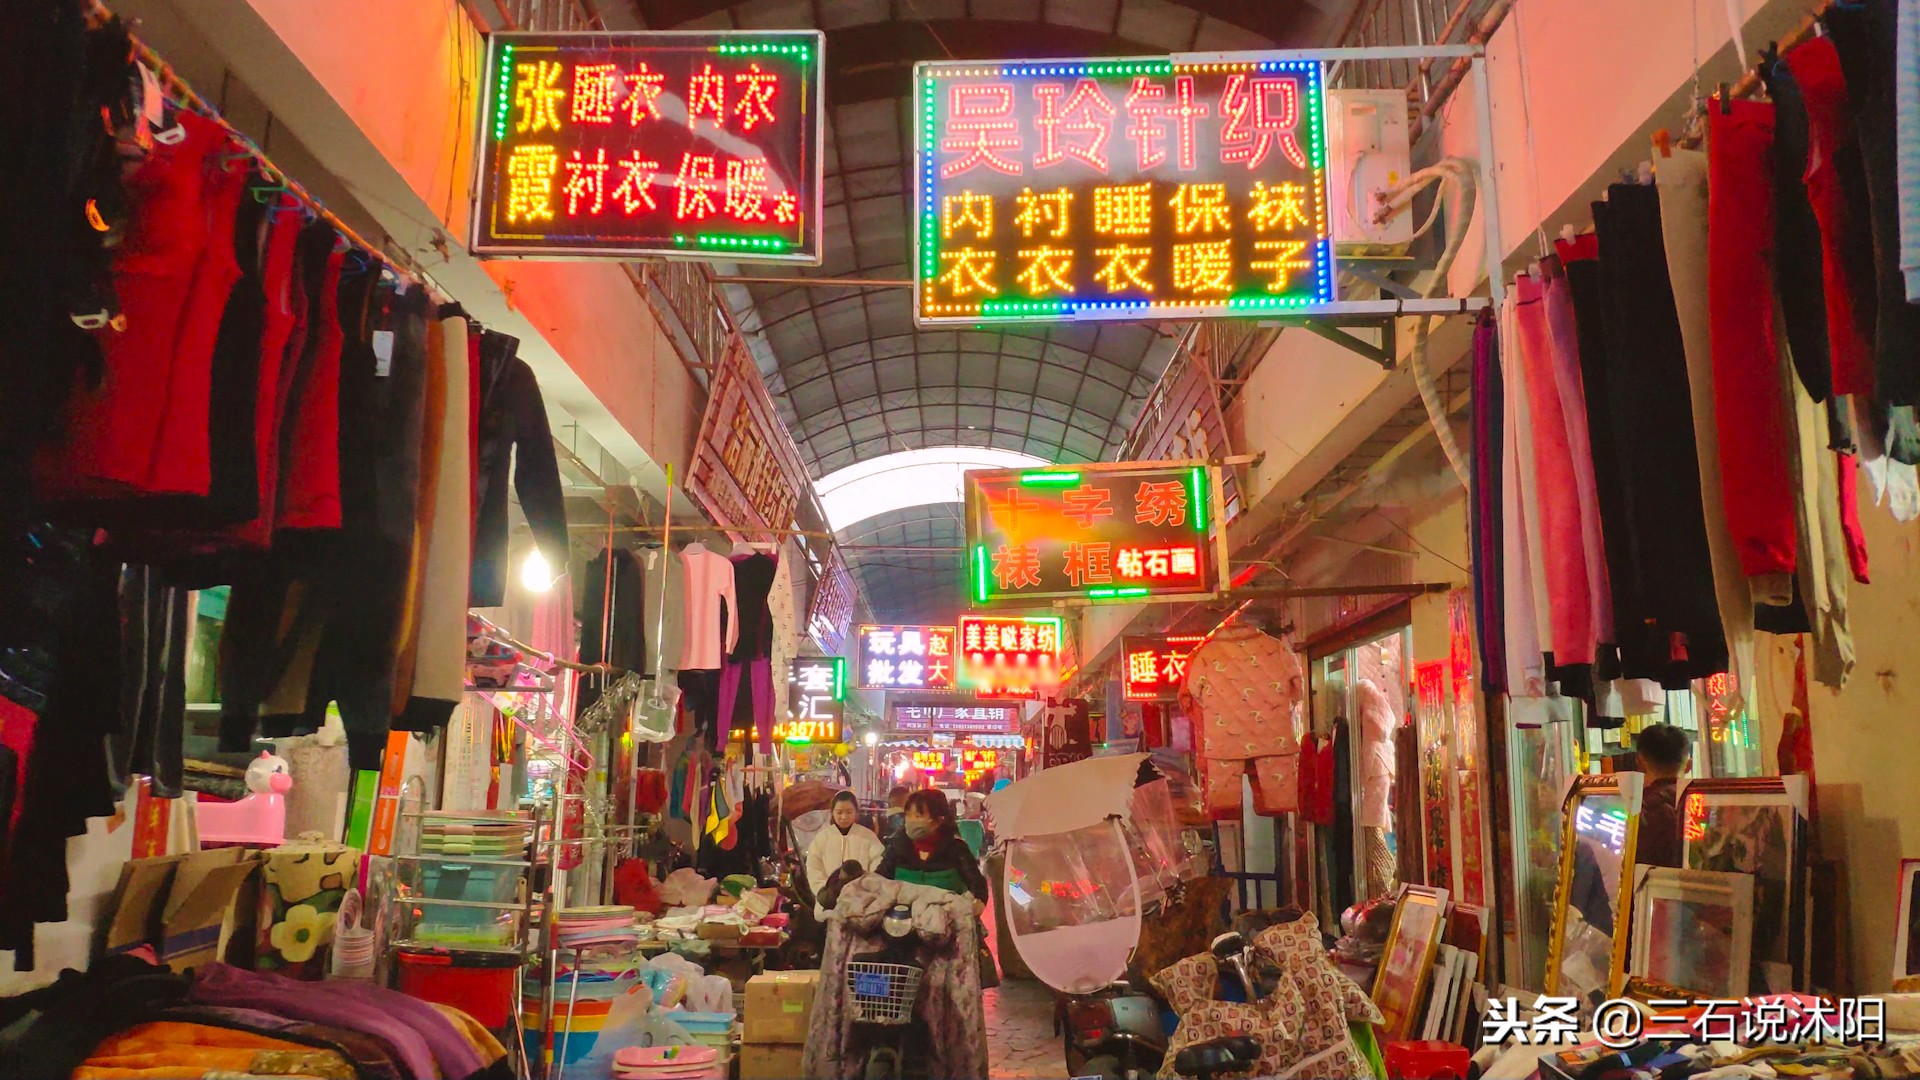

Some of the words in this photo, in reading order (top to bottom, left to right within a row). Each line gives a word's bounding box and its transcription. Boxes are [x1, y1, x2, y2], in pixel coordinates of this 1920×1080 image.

[571, 63, 664, 127] 睡衣
[688, 63, 777, 130] 内衣
[508, 60, 566, 223] 张霞
[941, 75, 1306, 179] 吴玲针织
[563, 148, 659, 216] 衬衣
[988, 480, 1187, 533] 十字绣
[992, 541, 1113, 590] 裱框
[1116, 547, 1195, 577] 钻石画
[868, 631, 926, 656] 玩具
[965, 623, 1055, 652] 美美哒家纺
[867, 658, 924, 685] 批发
[1129, 650, 1187, 683] 睡衣
